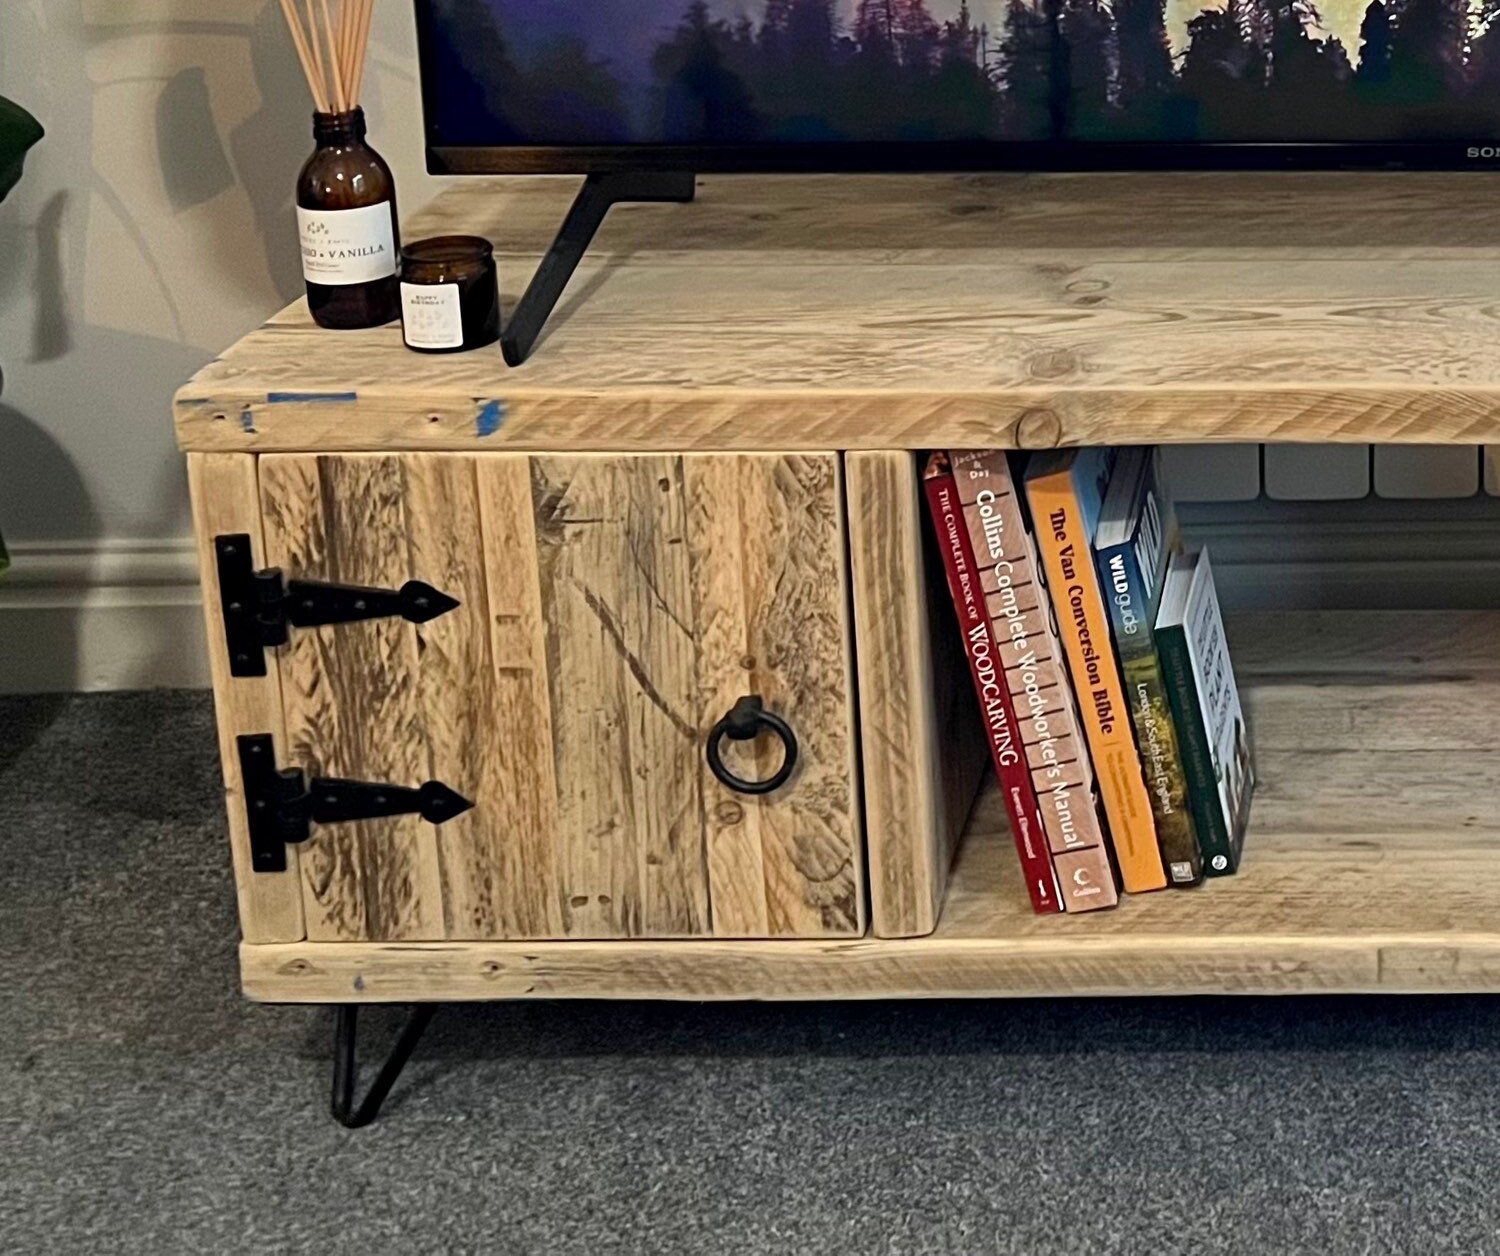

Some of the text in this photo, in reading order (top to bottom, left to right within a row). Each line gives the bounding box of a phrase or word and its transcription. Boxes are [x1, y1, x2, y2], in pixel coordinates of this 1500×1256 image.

[329, 244, 384, 258] VANILLA
[938, 488, 952, 513] THE
[944, 514, 967, 573] COMPLETE
[959, 573, 975, 605] BOOK
[1050, 507, 1115, 734] The Van Conversion Bible
[968, 622, 1018, 766] WOODCARVING
[977, 489, 1085, 849] Collins Complete Woodworker's Manual
[1148, 727, 1161, 755] South
[1156, 776, 1174, 814] England
